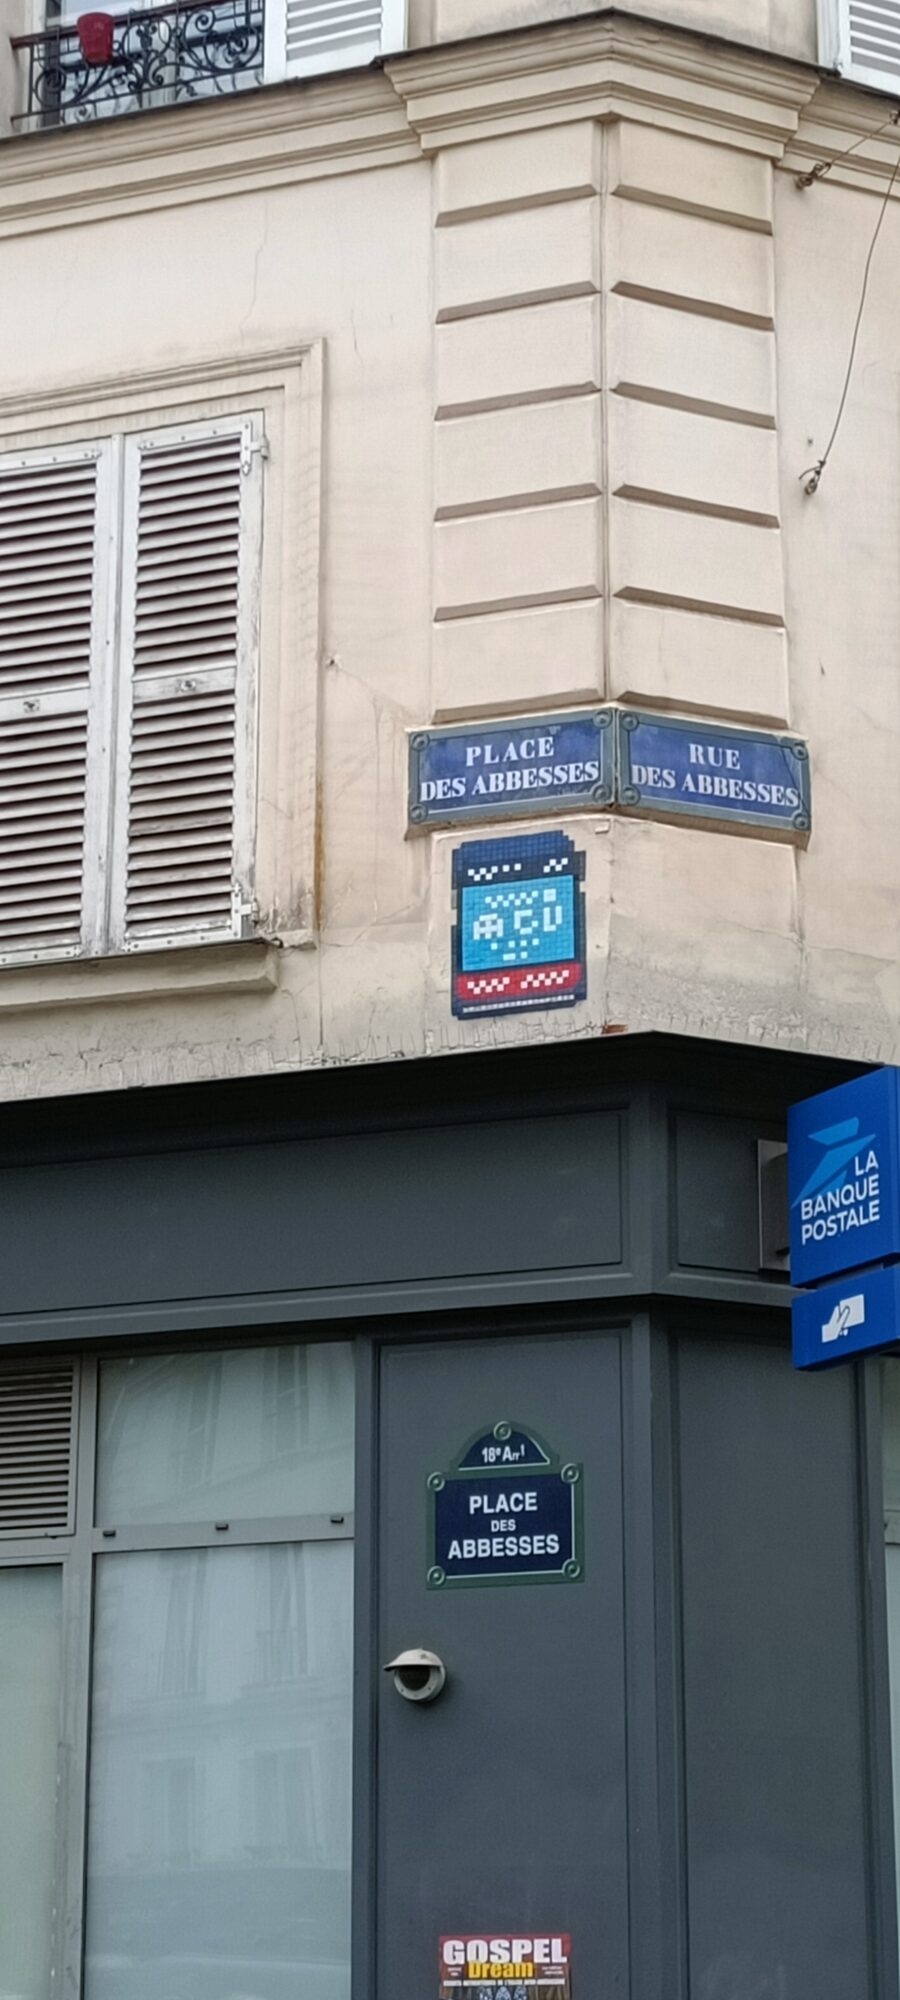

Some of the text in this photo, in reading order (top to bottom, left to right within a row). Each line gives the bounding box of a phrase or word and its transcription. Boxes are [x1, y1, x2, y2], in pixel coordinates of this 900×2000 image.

[466, 736, 554, 767] PLACE
[689, 744, 741, 771] RUE
[421, 761, 599, 802] DES ABBESSES
[631, 765, 799, 808] DES ABBESSES
[854, 1150, 879, 1176] LA
[801, 1174, 880, 1220] BANQUE
[802, 1200, 880, 1245] POSTALE
[469, 1492, 538, 1515] PLACE
[491, 1519, 516, 1532] DES
[447, 1534, 560, 1560] ABBESSES
[443, 1938, 567, 1965] GOSPEL
[468, 1961, 533, 1979] Dream
